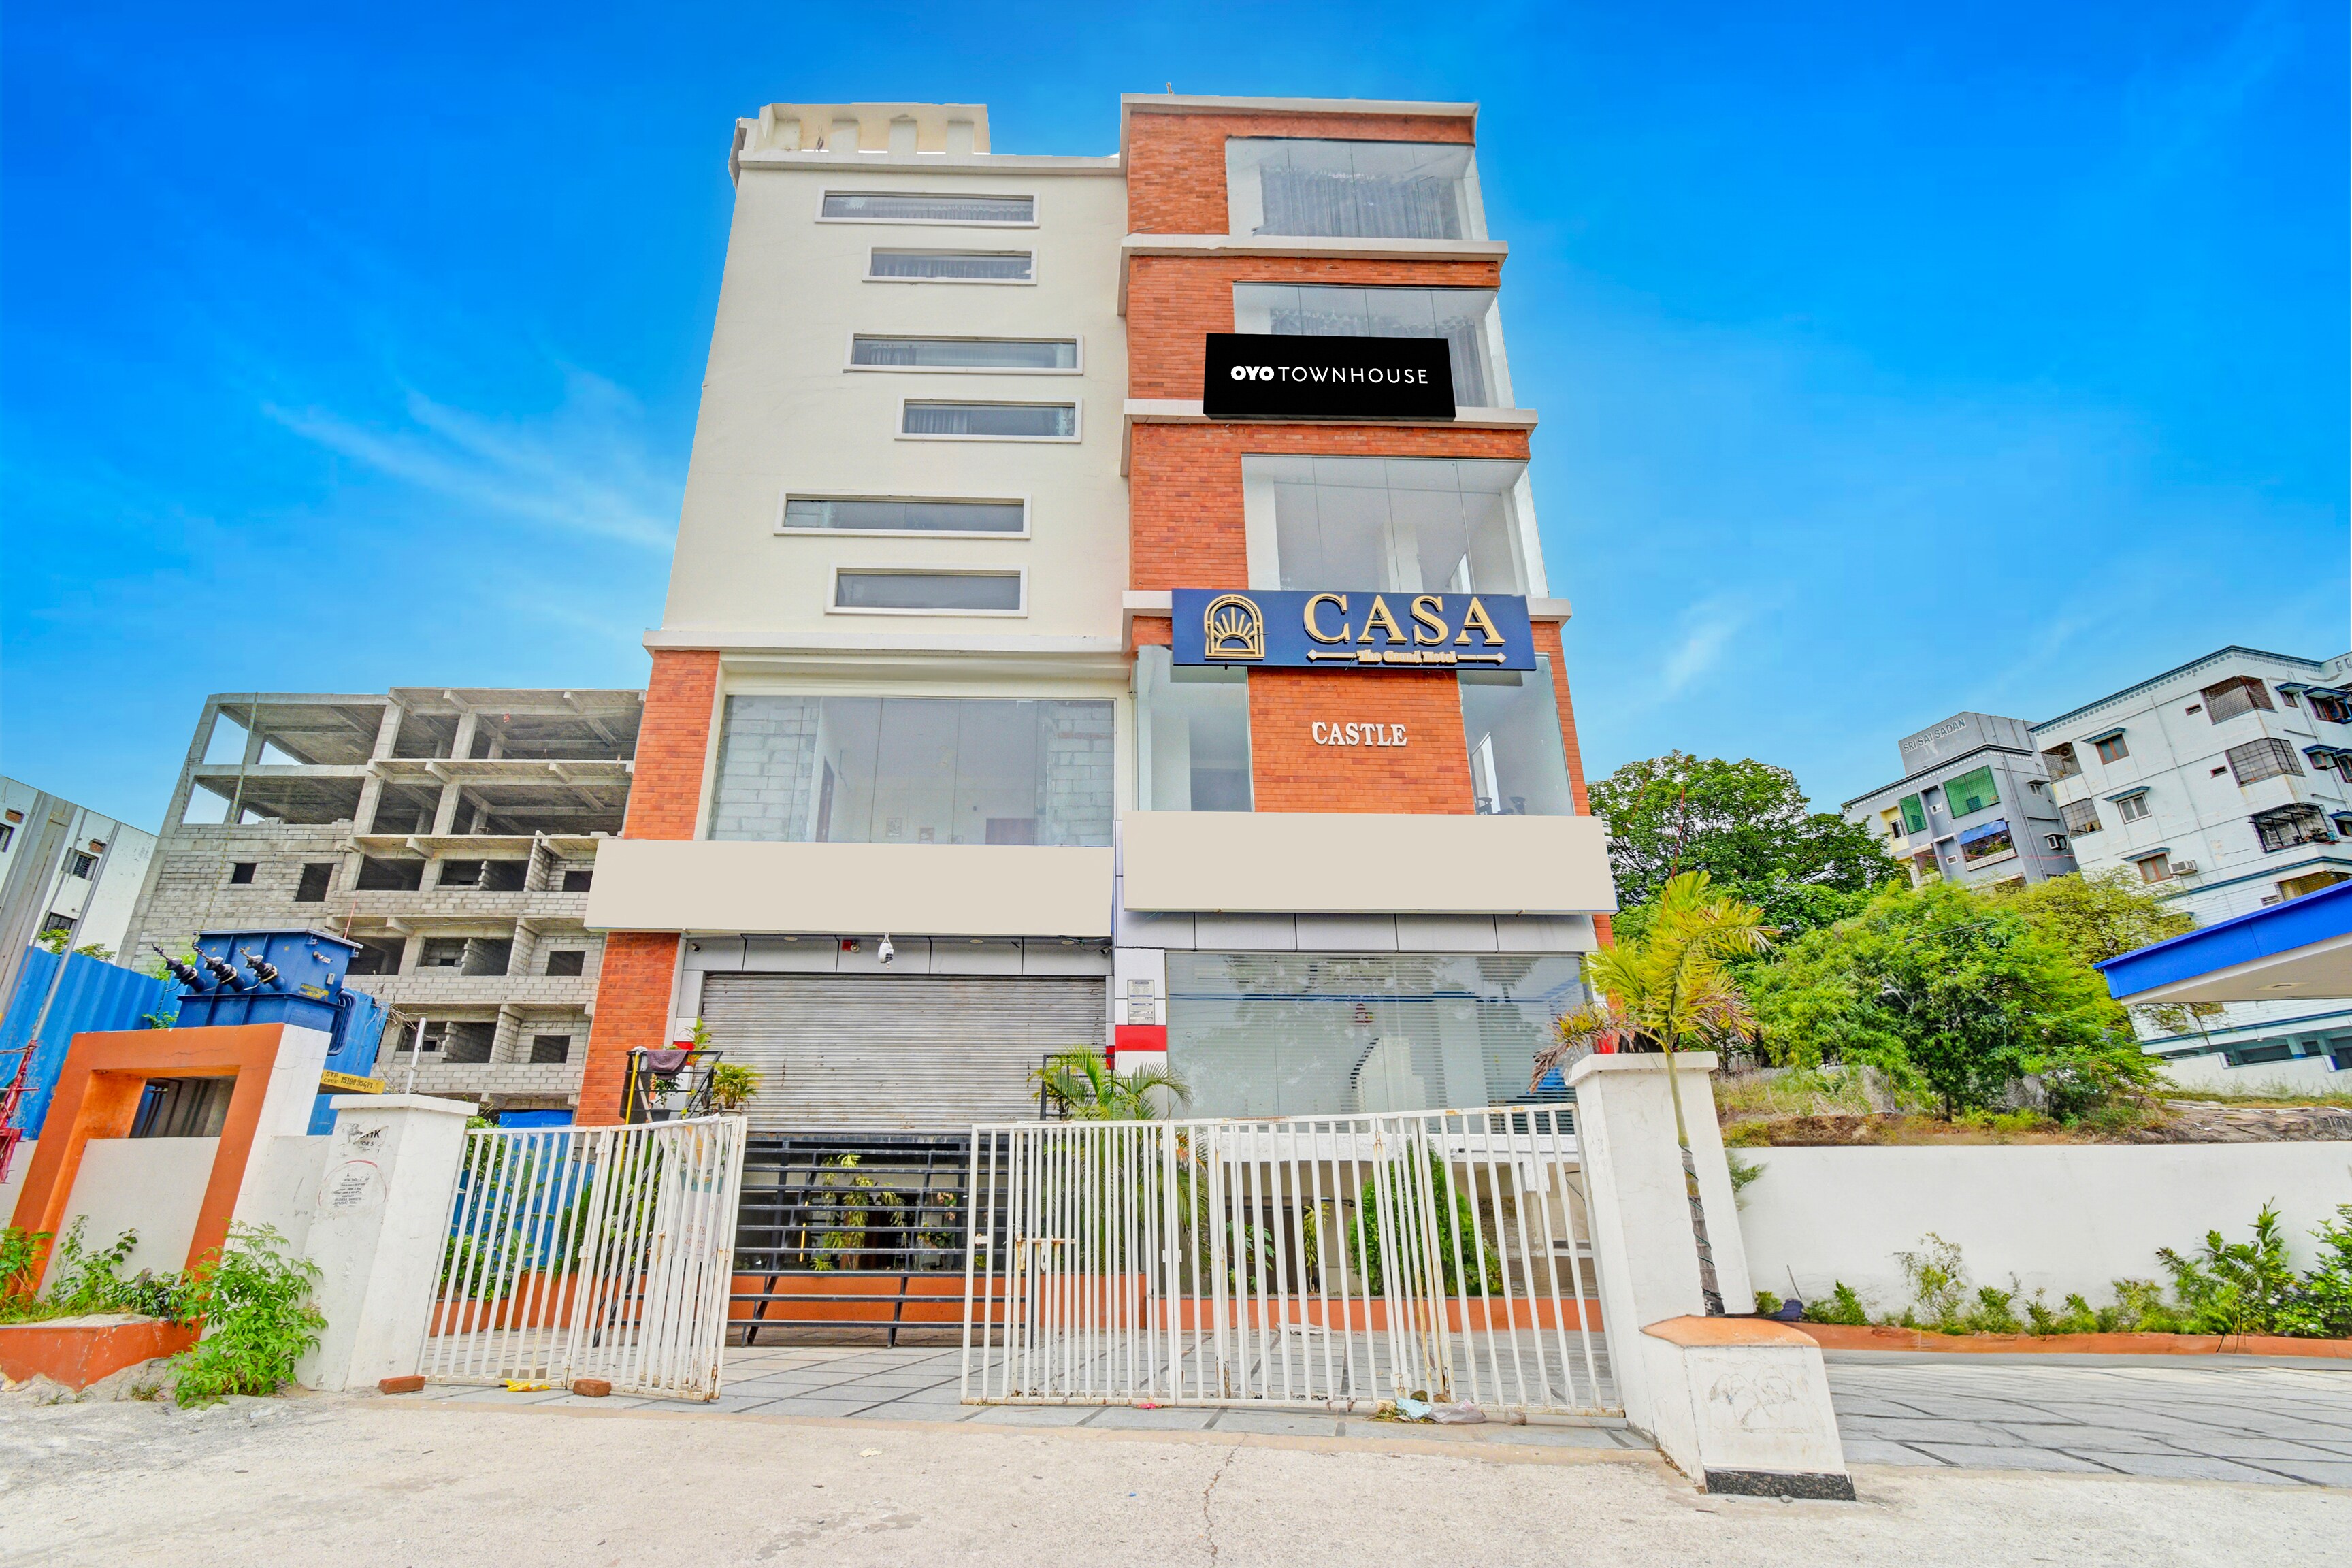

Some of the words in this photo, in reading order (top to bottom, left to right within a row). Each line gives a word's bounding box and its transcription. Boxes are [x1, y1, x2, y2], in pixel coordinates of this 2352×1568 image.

[1230, 365, 1275, 381] OYO
[1277, 366, 1428, 384] TOWNHOUSE
[1303, 593, 1505, 646] CASA
[1357, 649, 1382, 662] The
[1383, 650, 1422, 664] Grand
[1422, 651, 1458, 664] Hotel
[1311, 721, 1407, 747] CASTLE
[1903, 740, 1917, 753] SRI
[1917, 732, 1935, 747] SAI
[1934, 717, 1967, 739] SADAN
